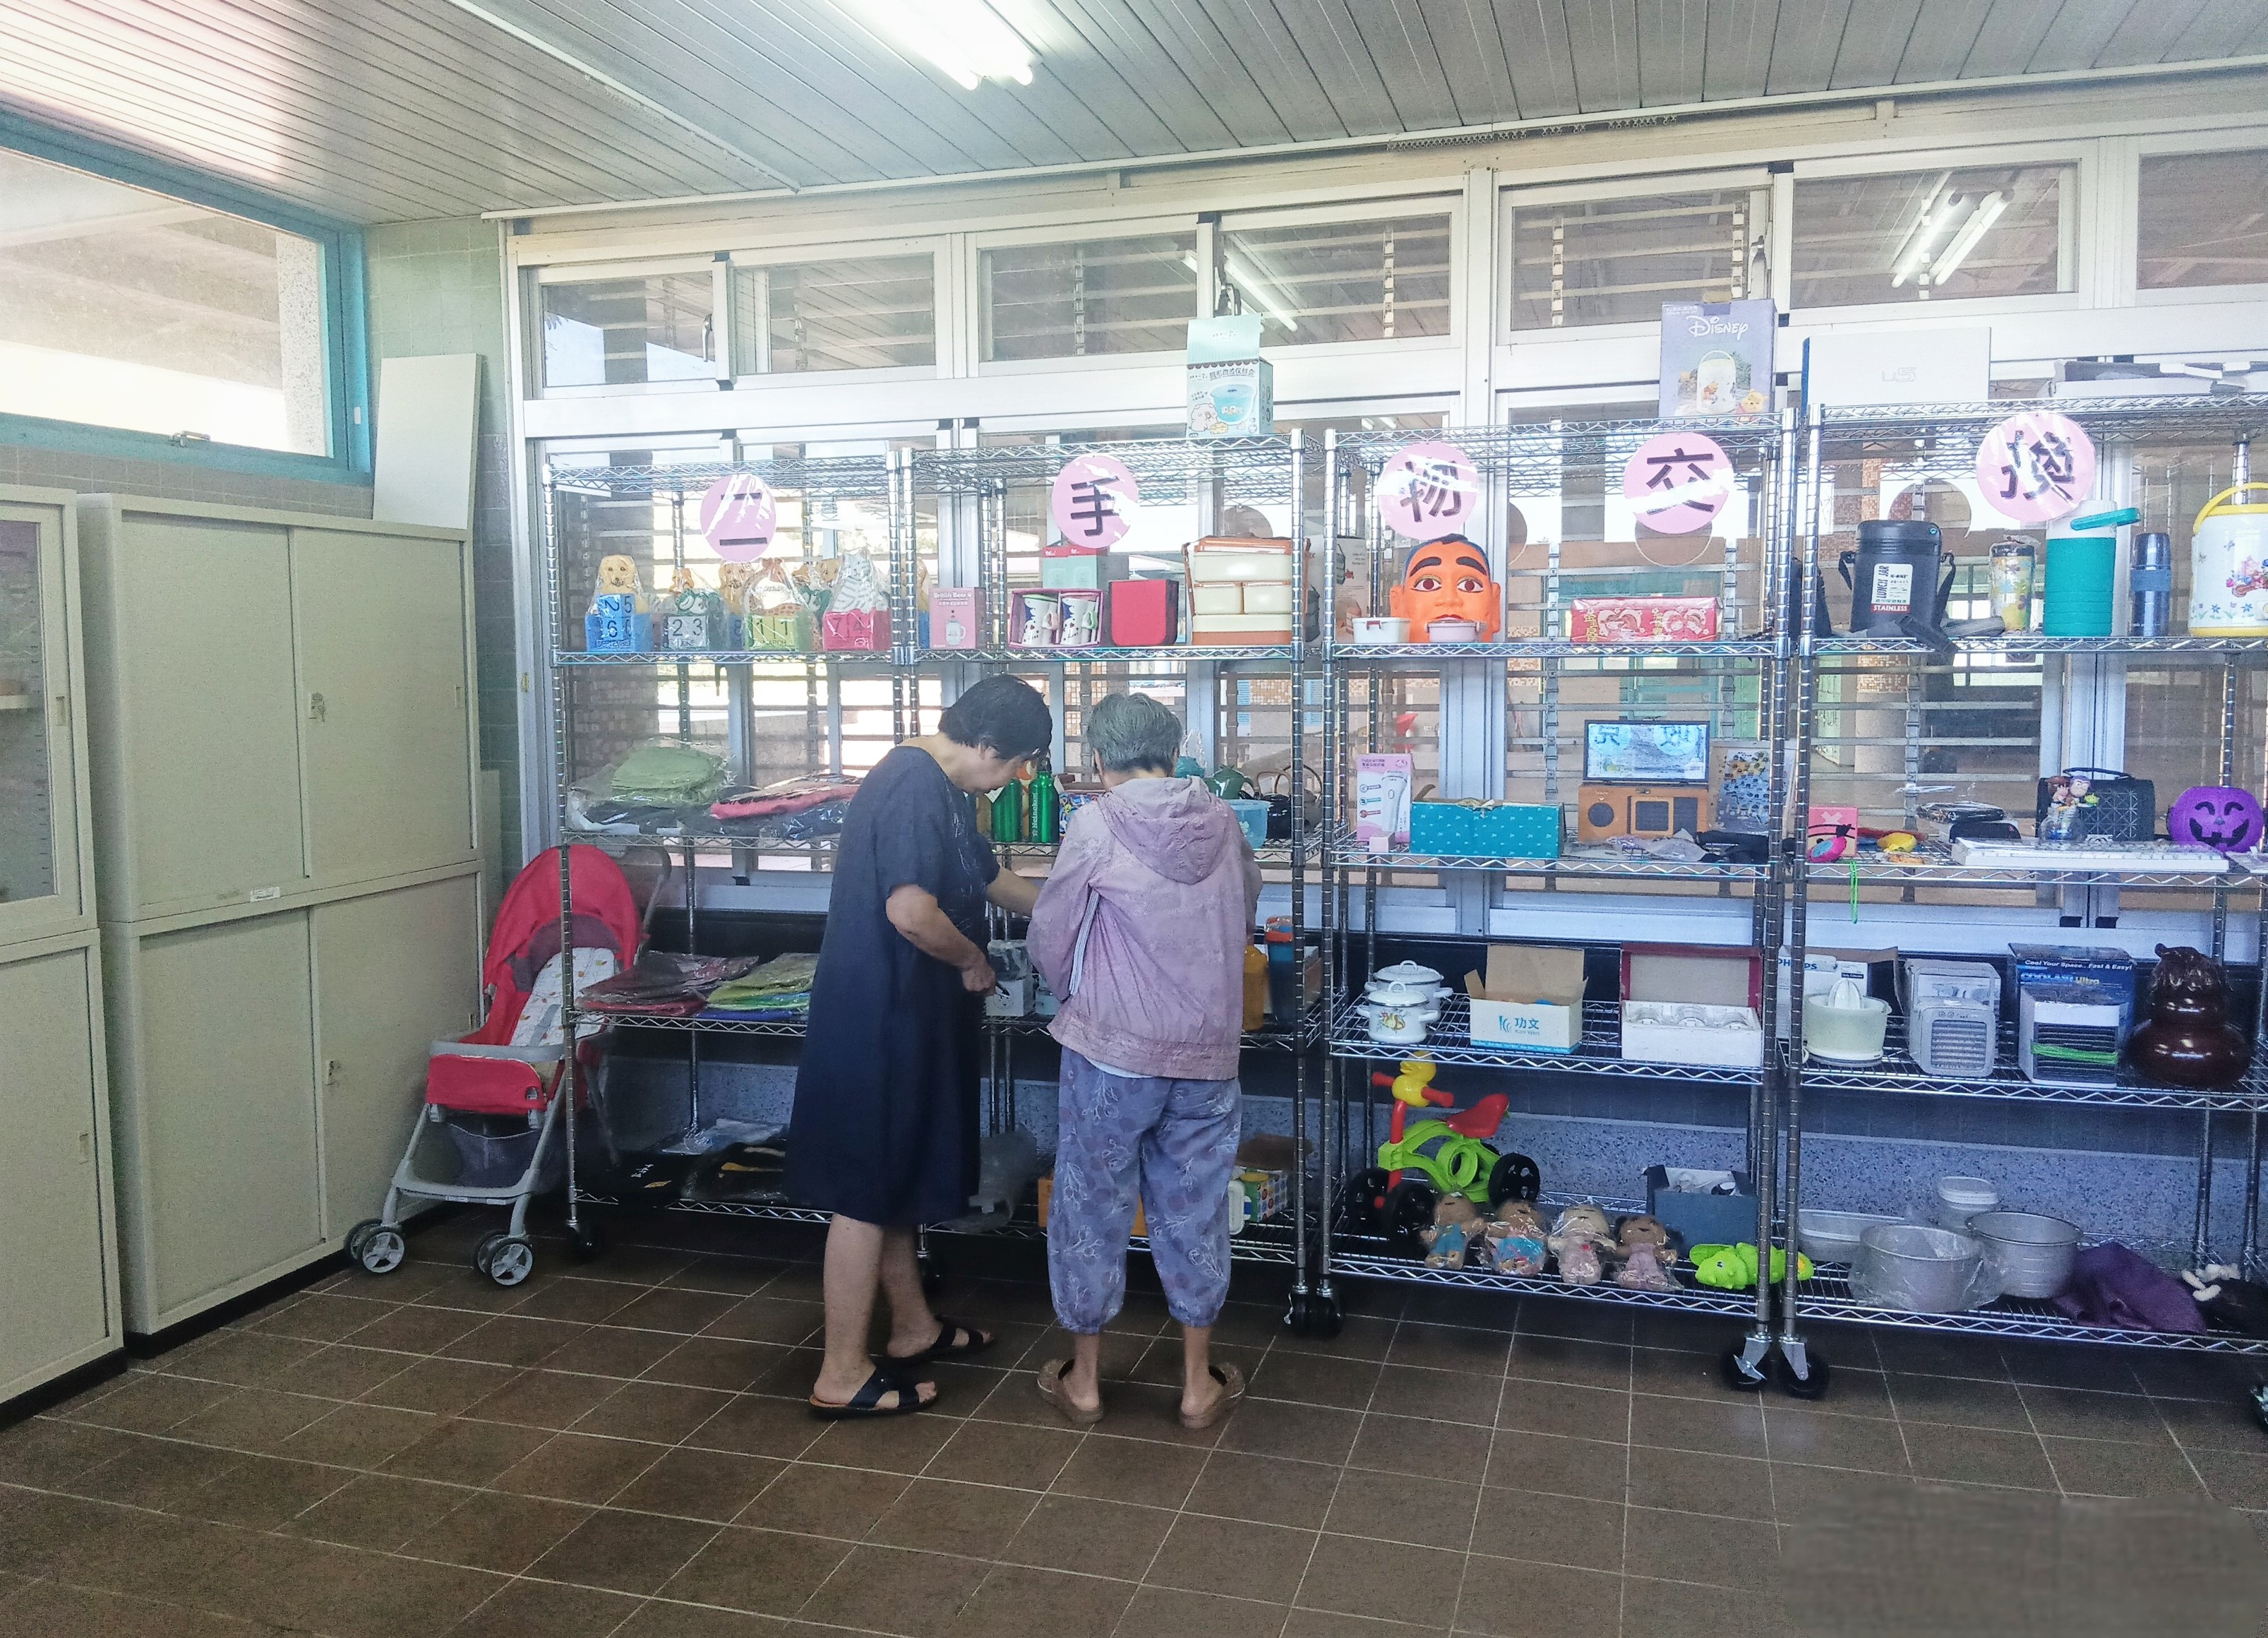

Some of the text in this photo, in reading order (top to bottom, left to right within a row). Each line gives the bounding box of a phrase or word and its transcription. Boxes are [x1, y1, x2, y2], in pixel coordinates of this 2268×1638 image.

[1686, 316, 1748, 341] Disney
[719, 430, 2077, 546] 二 手 物 交 換
[1876, 566, 1890, 599] LUNCH JAR
[1514, 1017, 1540, 1029] 功文
